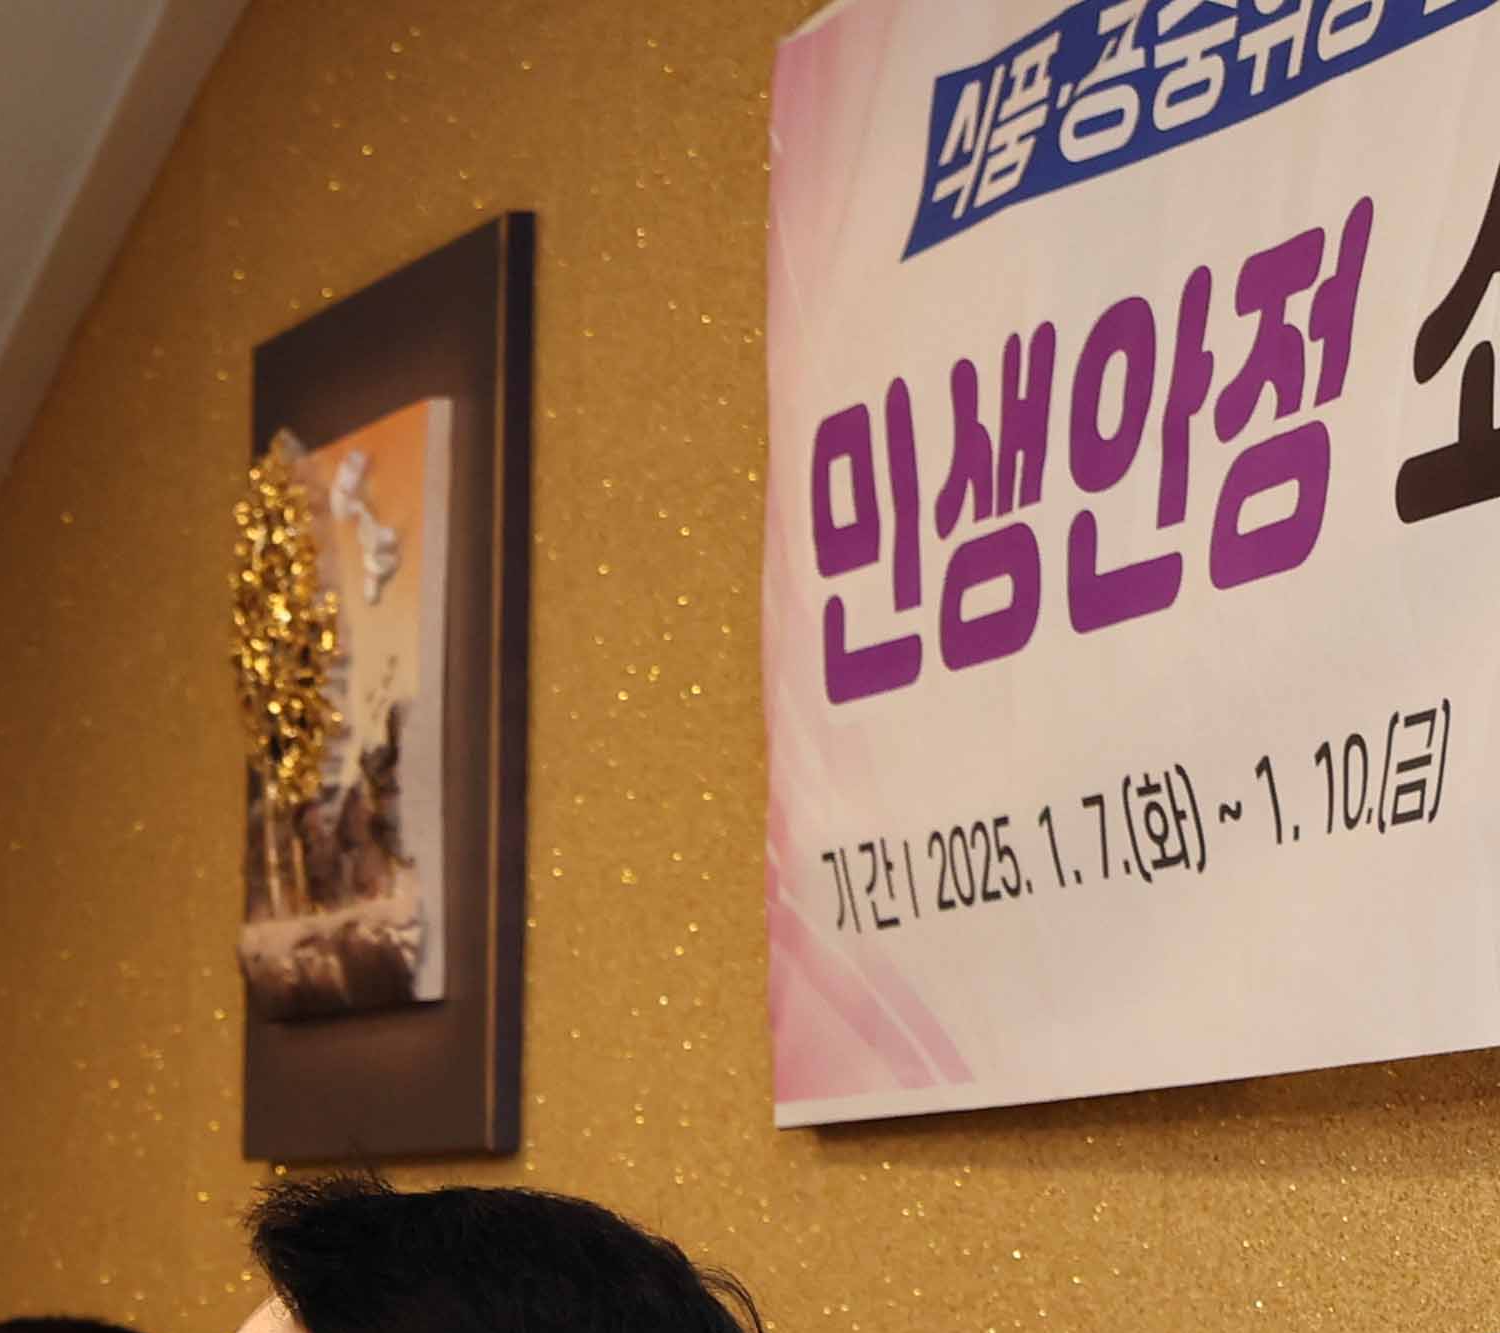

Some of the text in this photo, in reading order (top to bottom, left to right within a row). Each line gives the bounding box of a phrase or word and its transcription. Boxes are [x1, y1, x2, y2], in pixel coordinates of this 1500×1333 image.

[812, 196, 1375, 706] 민생안정
[821, 833, 902, 934] 기간
[927, 814, 1034, 912] 2025.
